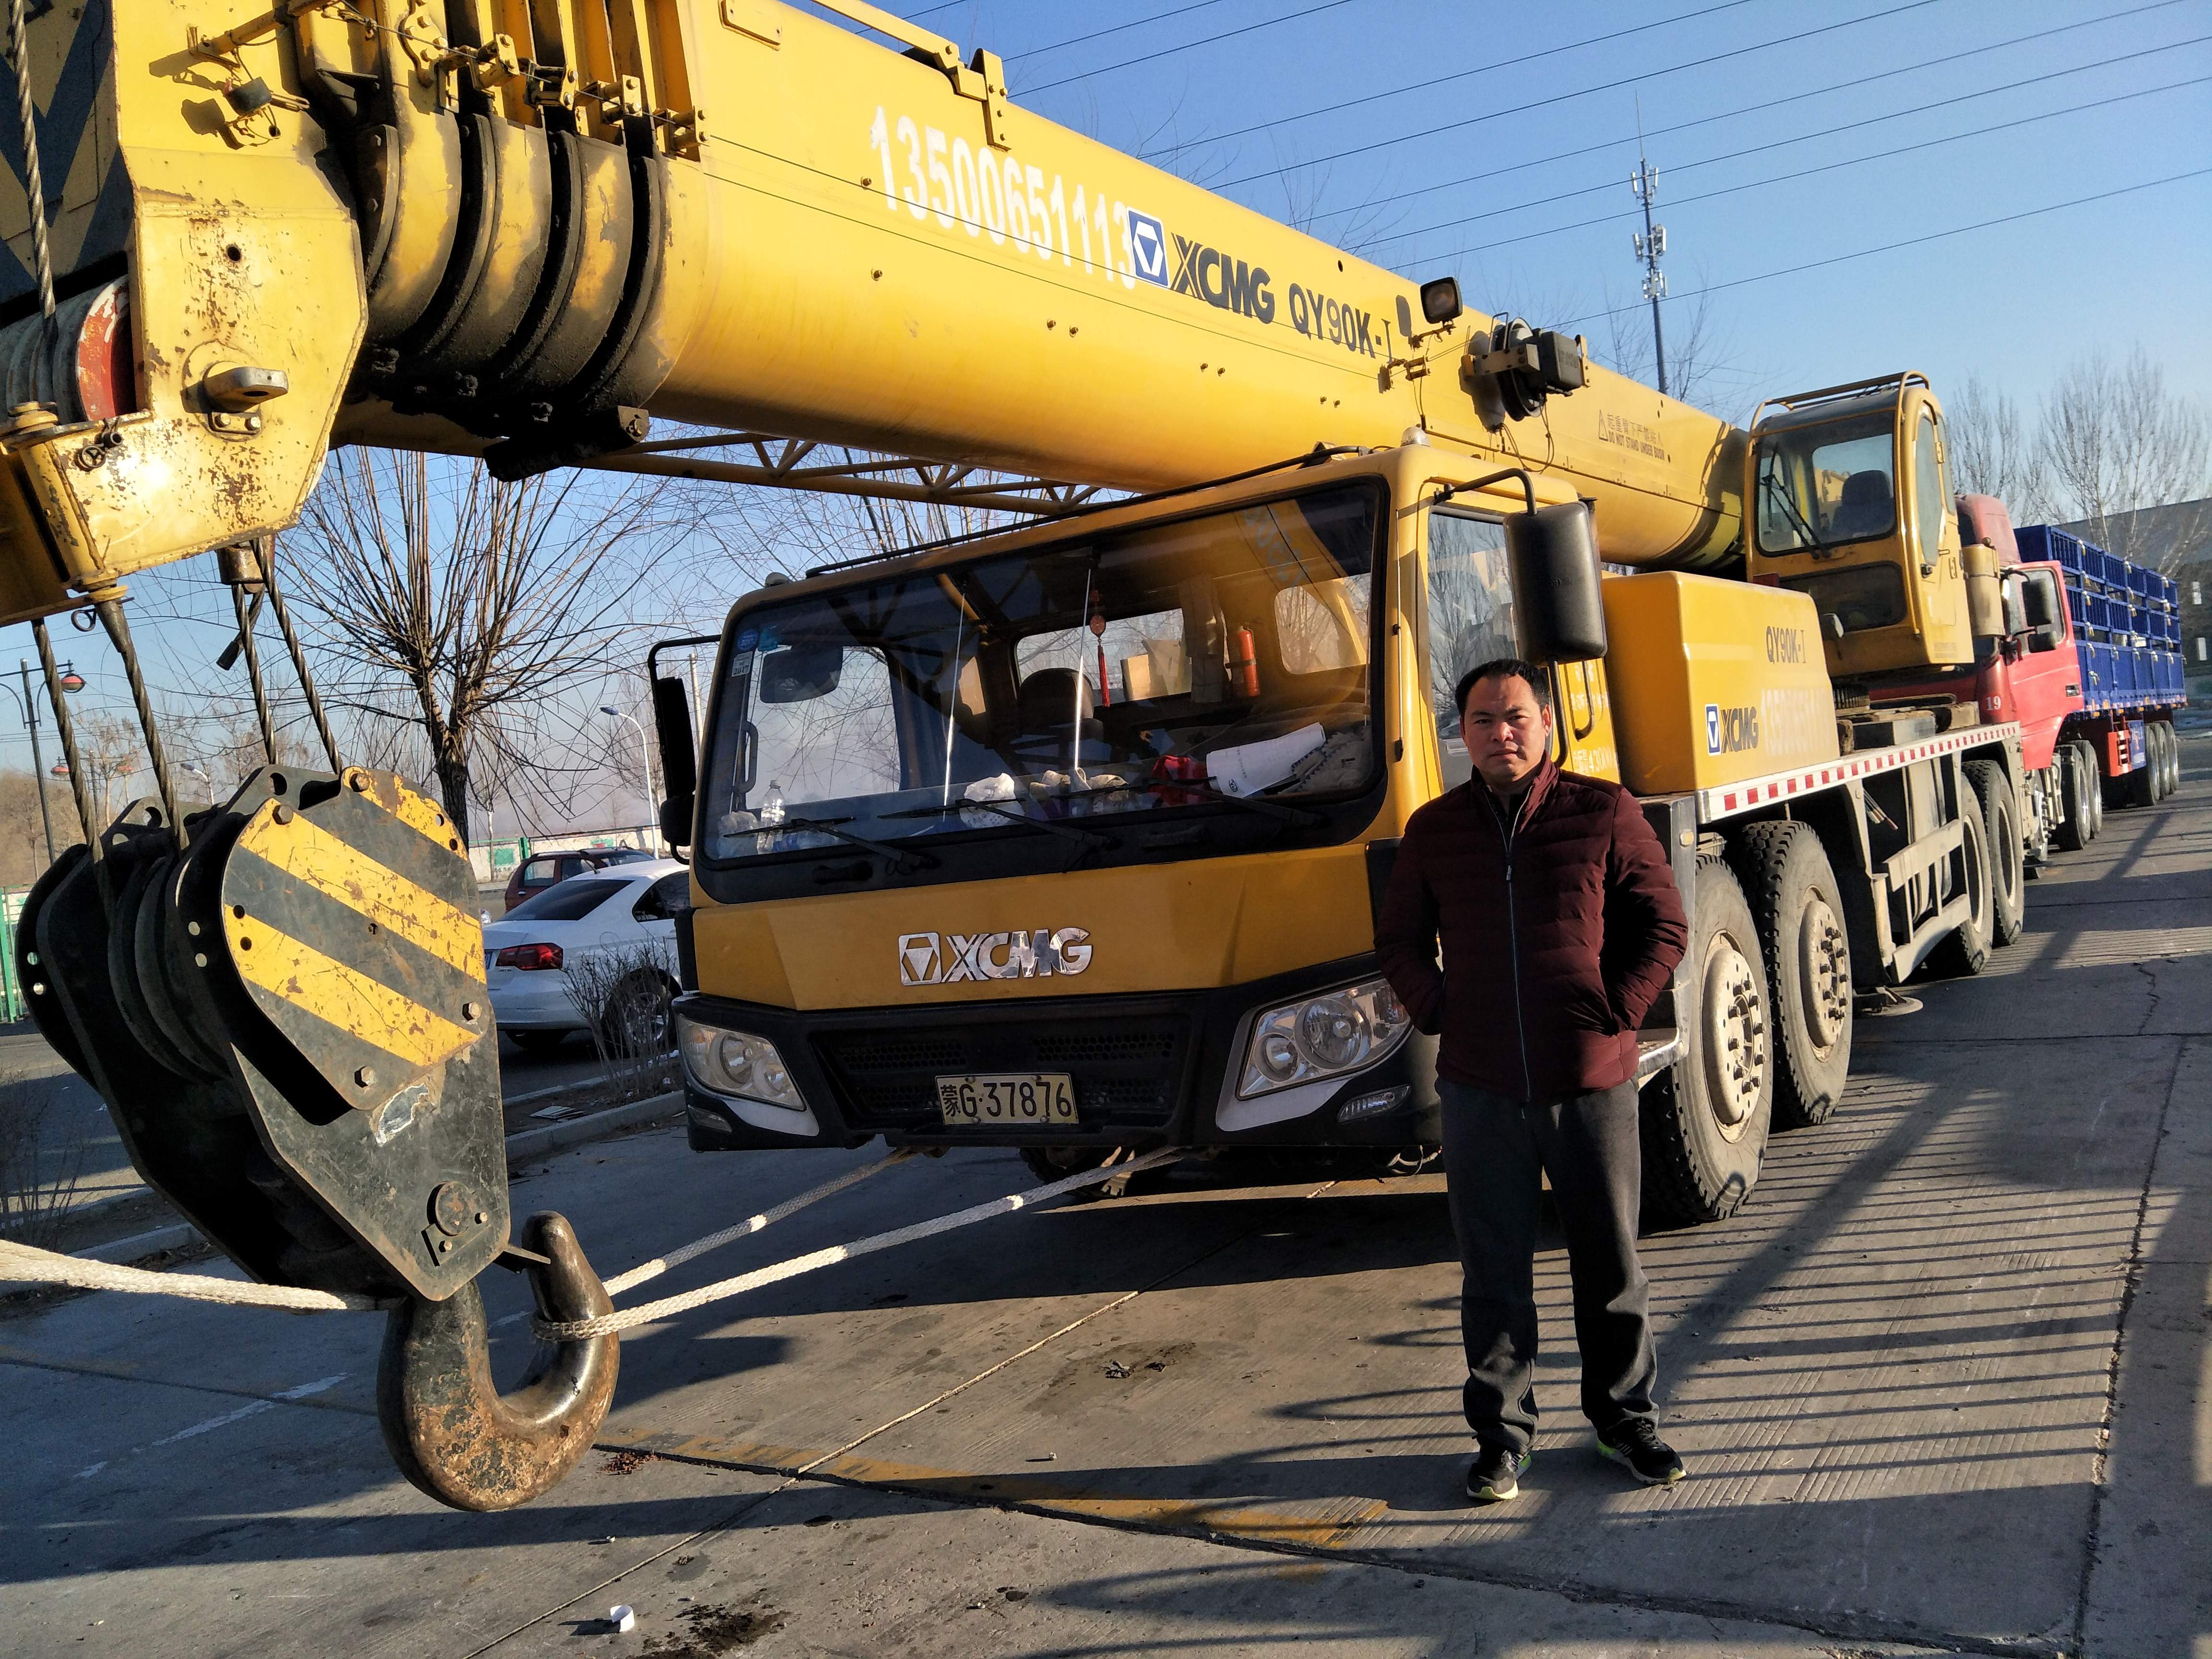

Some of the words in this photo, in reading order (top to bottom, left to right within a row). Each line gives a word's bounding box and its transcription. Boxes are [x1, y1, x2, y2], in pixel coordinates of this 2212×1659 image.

[870, 105, 1135, 289] 13500651113
[1170, 232, 1275, 325] XCMG
[1721, 706, 1759, 753] XCMG
[1986, 696, 2001, 710] 19
[941, 927, 1093, 983] XCMG
